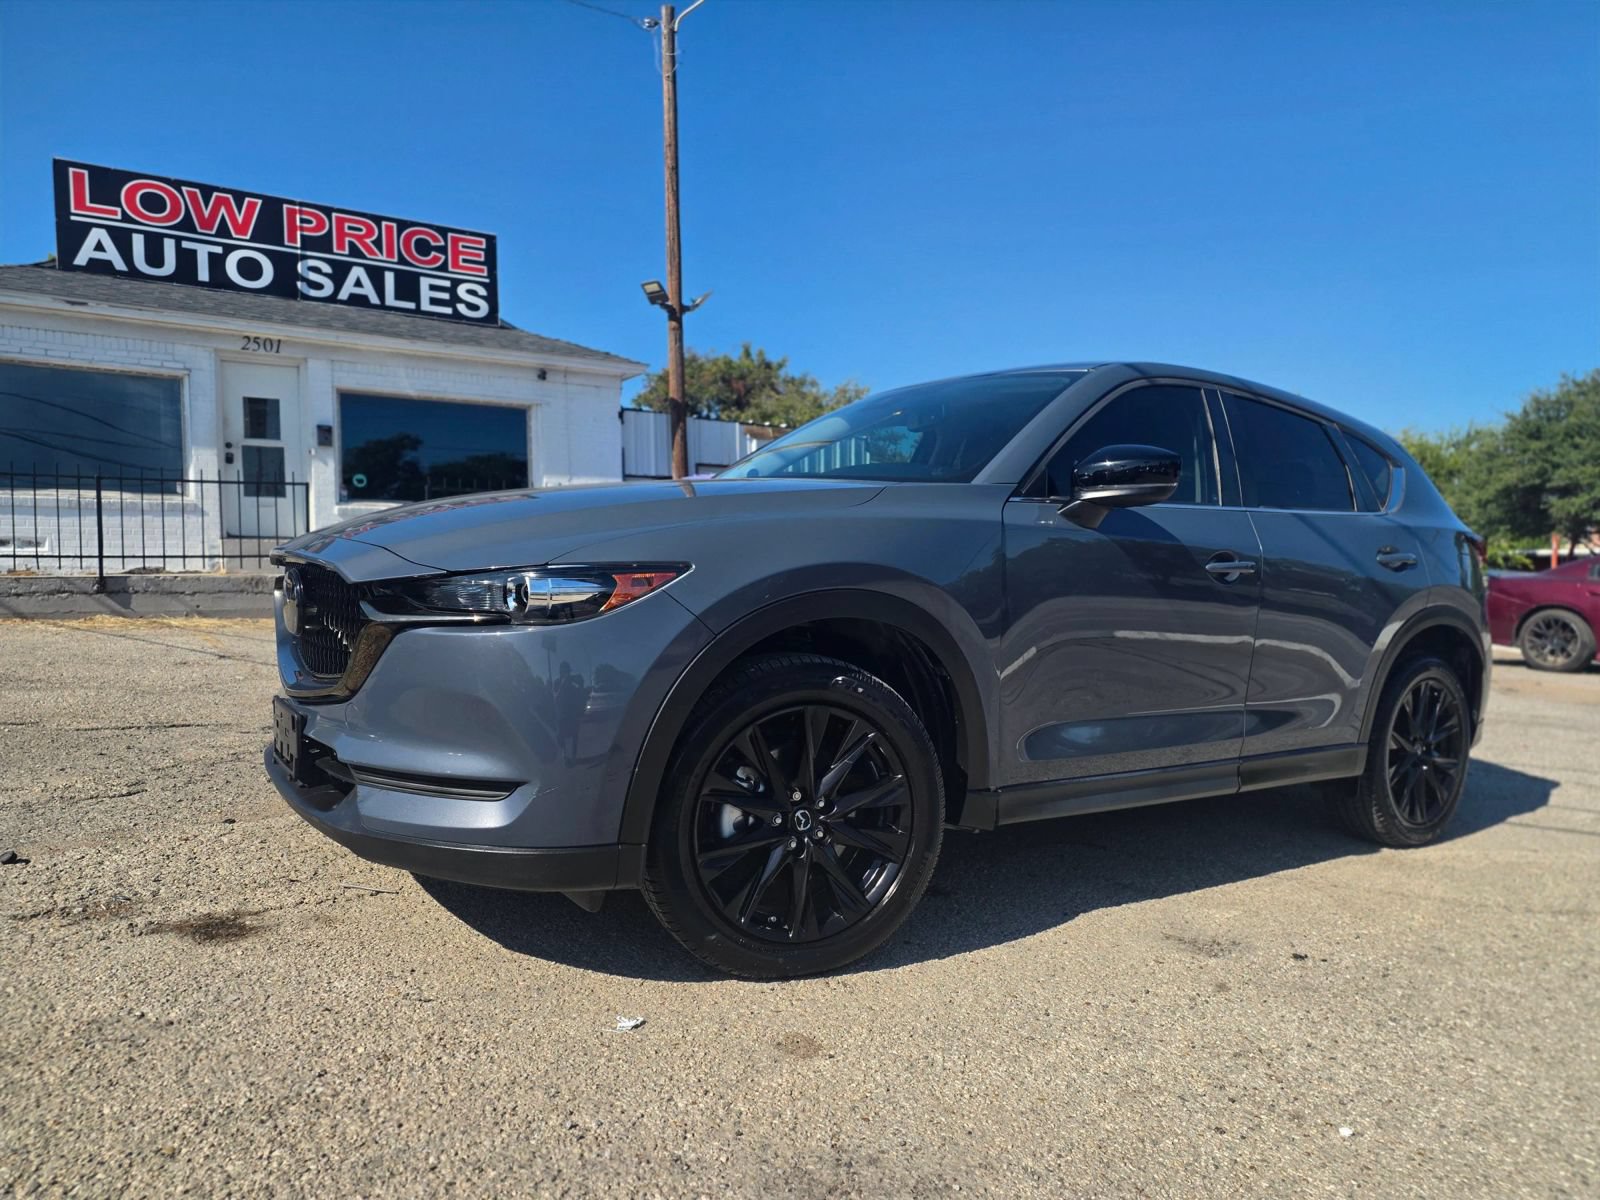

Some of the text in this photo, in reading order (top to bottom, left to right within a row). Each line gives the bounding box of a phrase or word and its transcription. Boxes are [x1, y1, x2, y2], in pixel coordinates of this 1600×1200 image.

[68, 167, 488, 276] LOW PRICE
[72, 227, 489, 319] AUTO SALES
[241, 335, 282, 354] 2501
